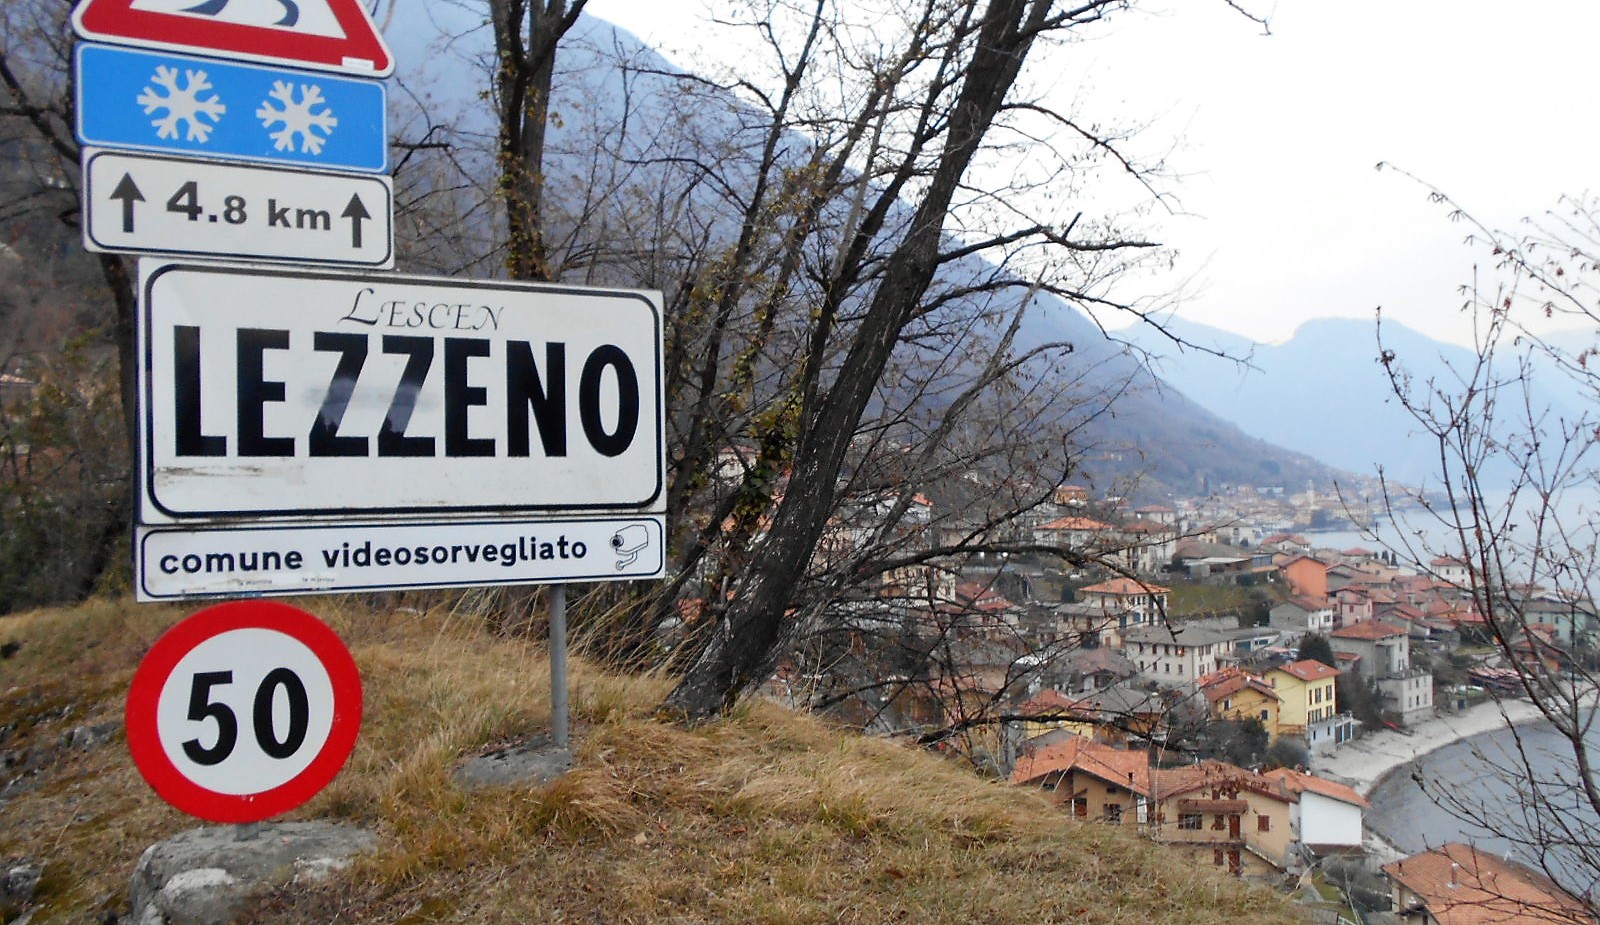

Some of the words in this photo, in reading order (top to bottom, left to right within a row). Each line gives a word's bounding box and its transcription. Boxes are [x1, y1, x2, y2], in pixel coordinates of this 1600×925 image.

[166, 181, 247, 225] 4.8
[268, 198, 331, 231] km
[338, 288, 504, 330] LESCEN
[173, 324, 640, 458] LEZZENO
[160, 550, 303, 575] comune
[322, 534, 588, 570] videosorvegliato
[182, 667, 309, 766] 50
